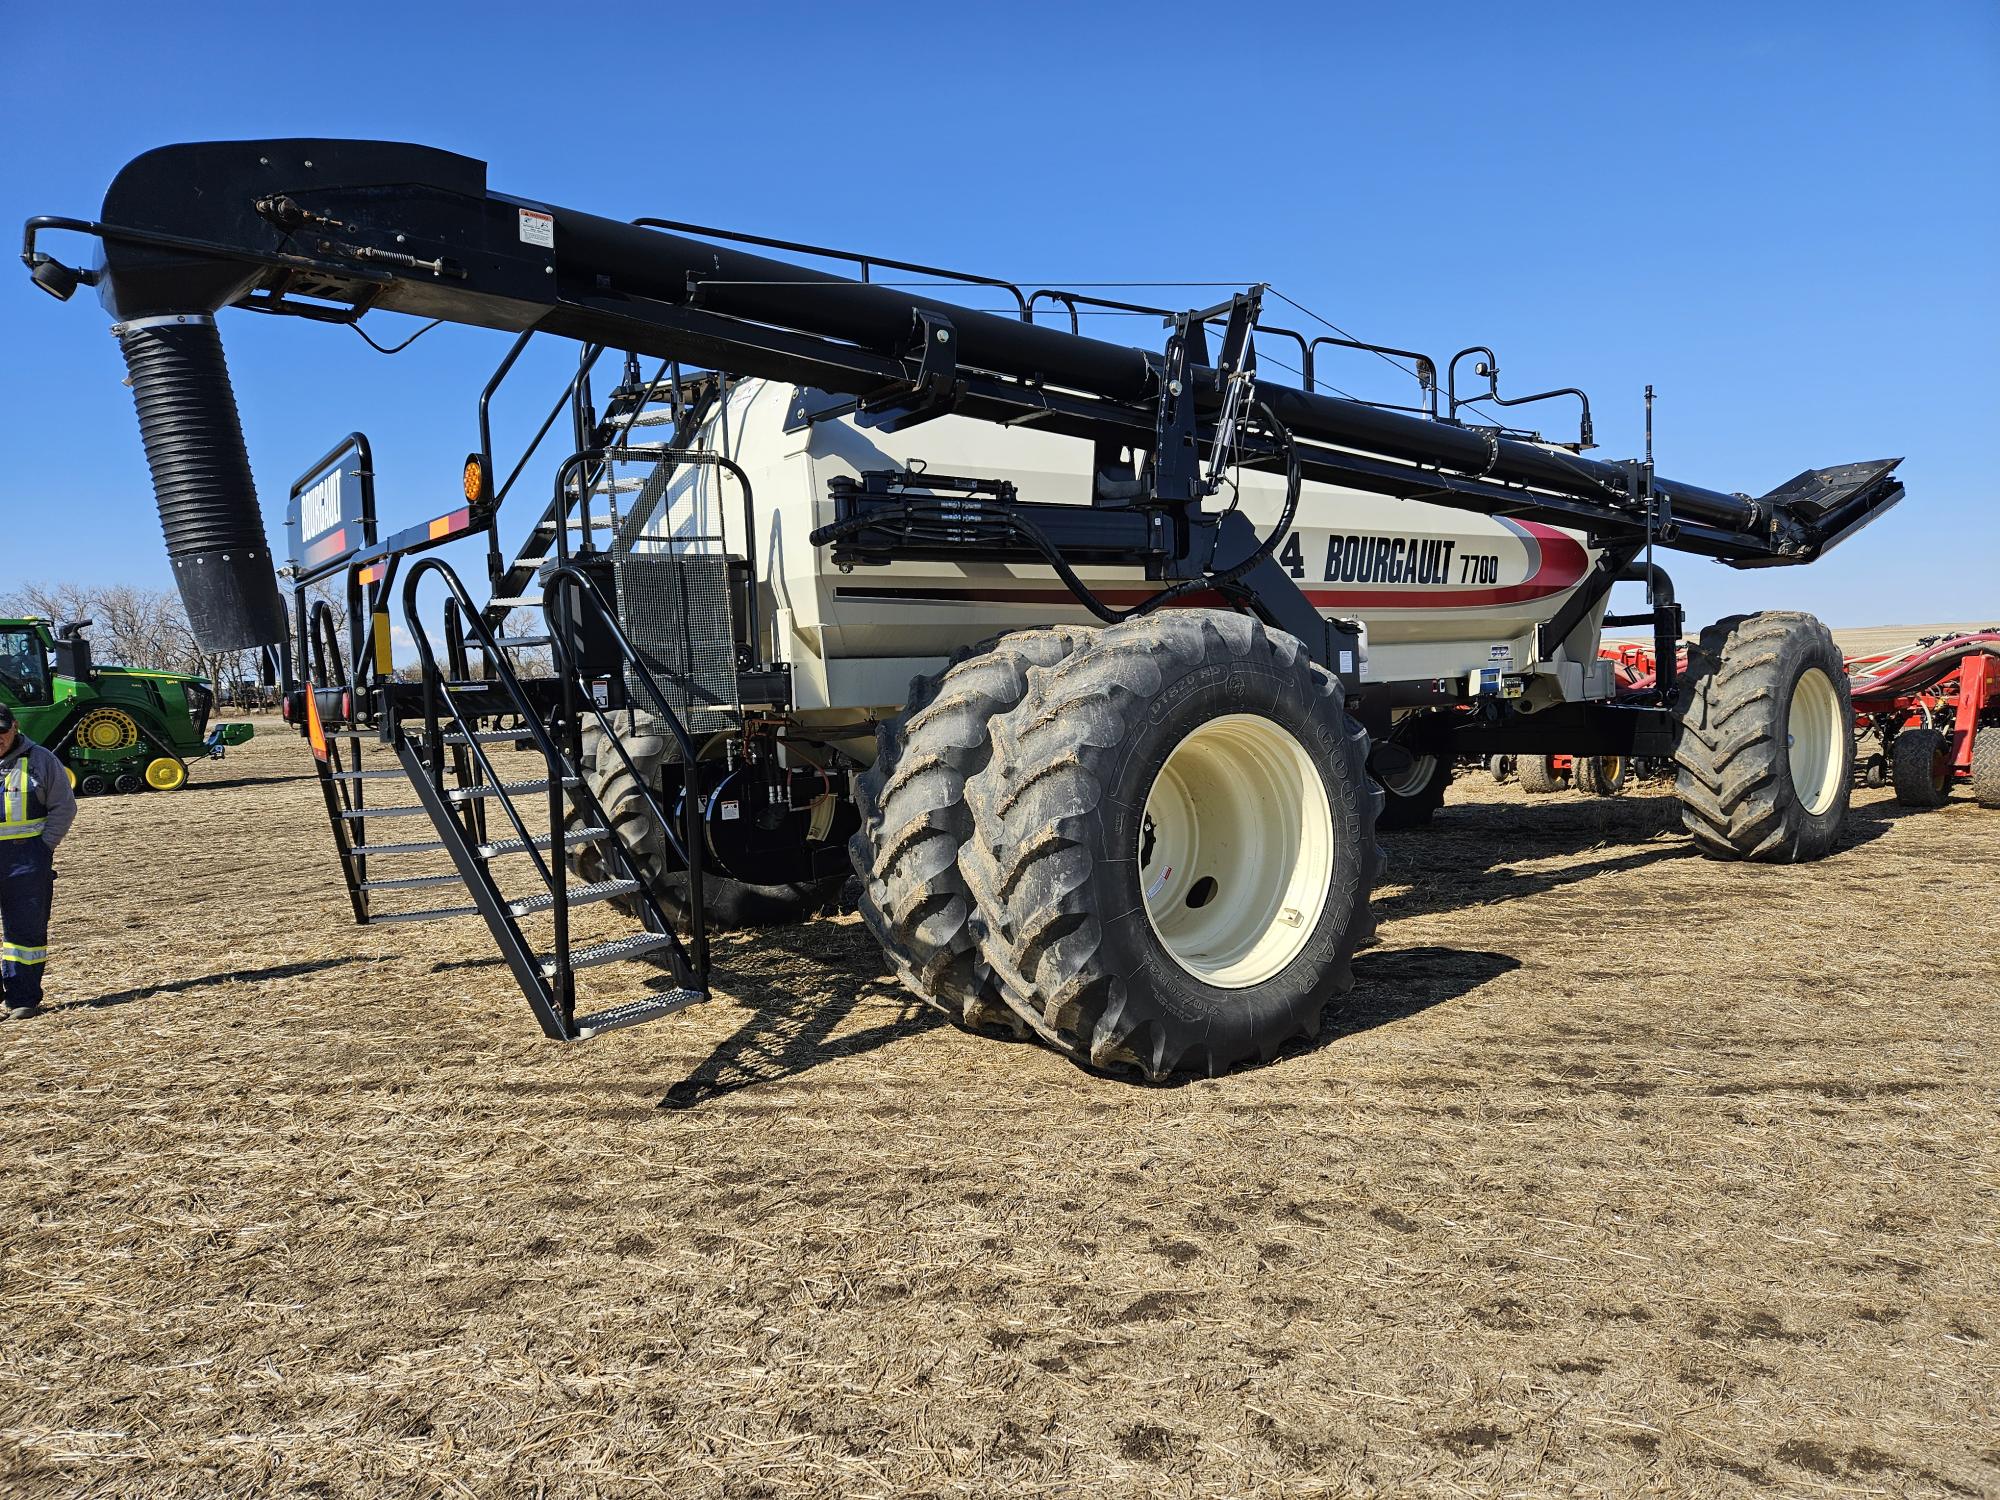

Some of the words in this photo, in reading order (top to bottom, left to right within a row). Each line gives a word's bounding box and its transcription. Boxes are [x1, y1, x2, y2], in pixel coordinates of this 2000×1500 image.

[301, 468, 342, 543] BOURGAULT
[1279, 532, 1305, 578] 4
[1324, 534, 1456, 584] BOURGAULT
[1460, 555, 1499, 584] 7700
[1298, 723, 1362, 995] GOODYEAR
